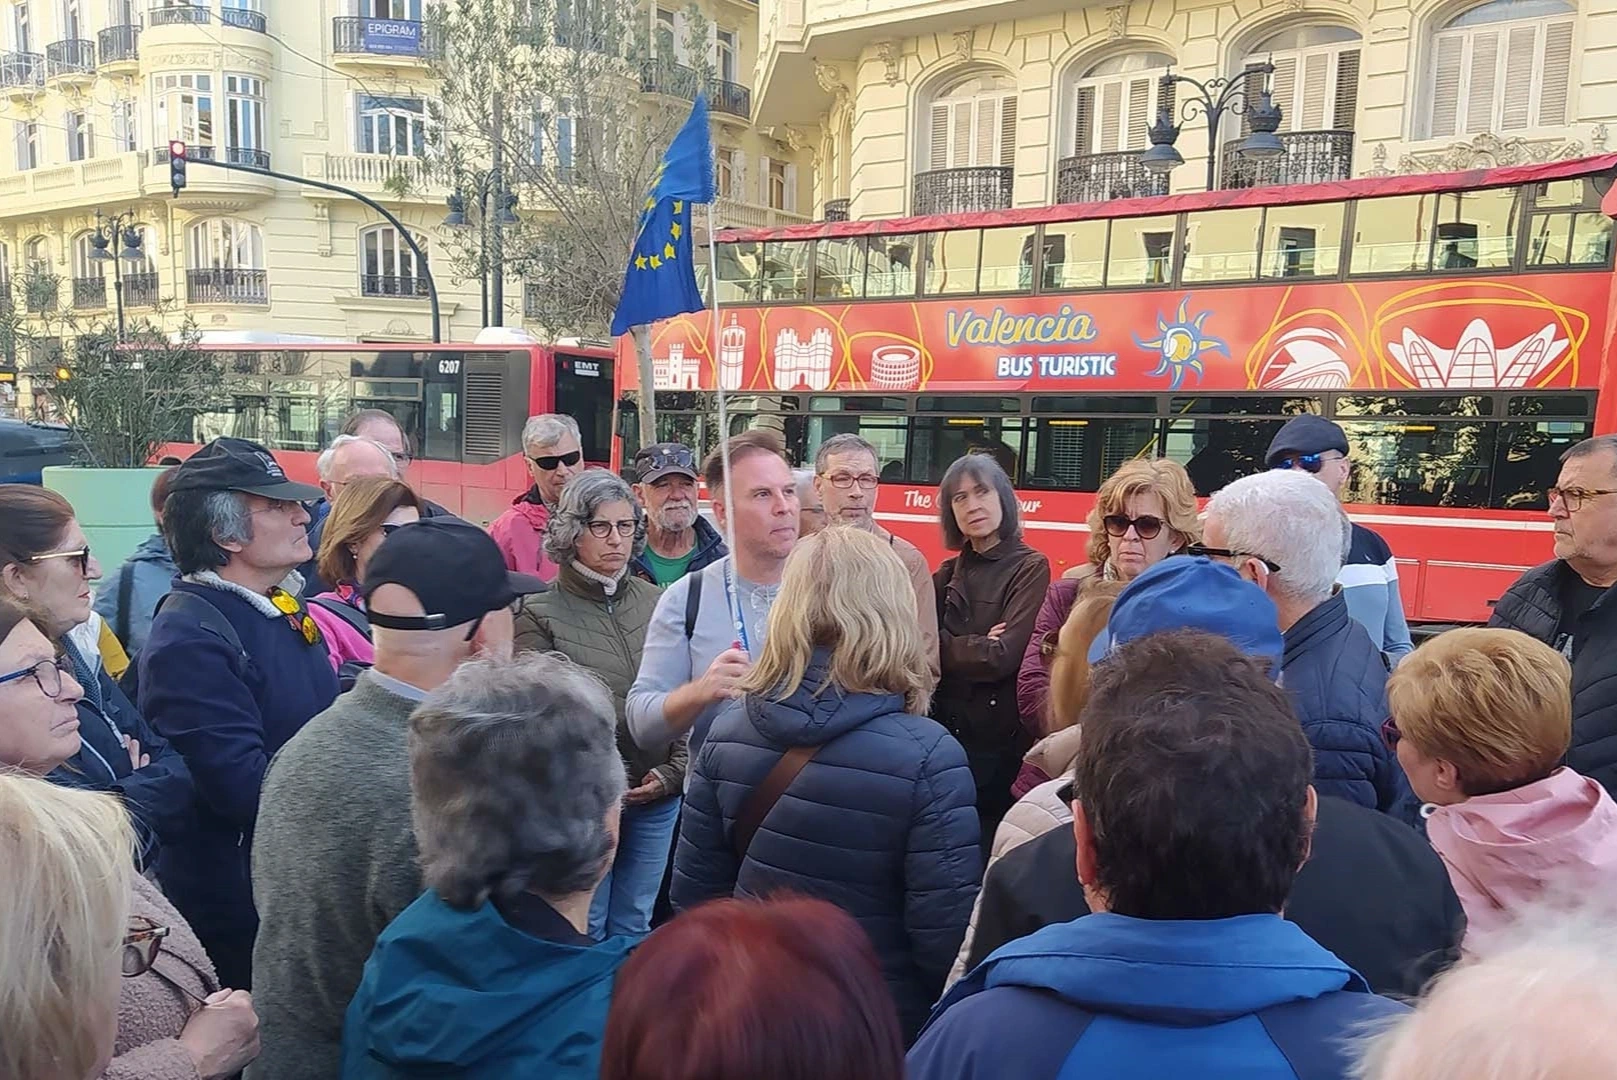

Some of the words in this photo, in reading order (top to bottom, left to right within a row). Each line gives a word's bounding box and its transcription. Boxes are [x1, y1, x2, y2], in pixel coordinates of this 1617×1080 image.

[367, 23, 416, 36] EPIGRAM
[946, 306, 1097, 347] Valencia
[438, 360, 460, 374] 6207
[574, 361, 599, 371] EMT
[997, 356, 1033, 377] BUS
[1038, 355, 1117, 376] TURISTIC
[904, 490, 932, 508] The
